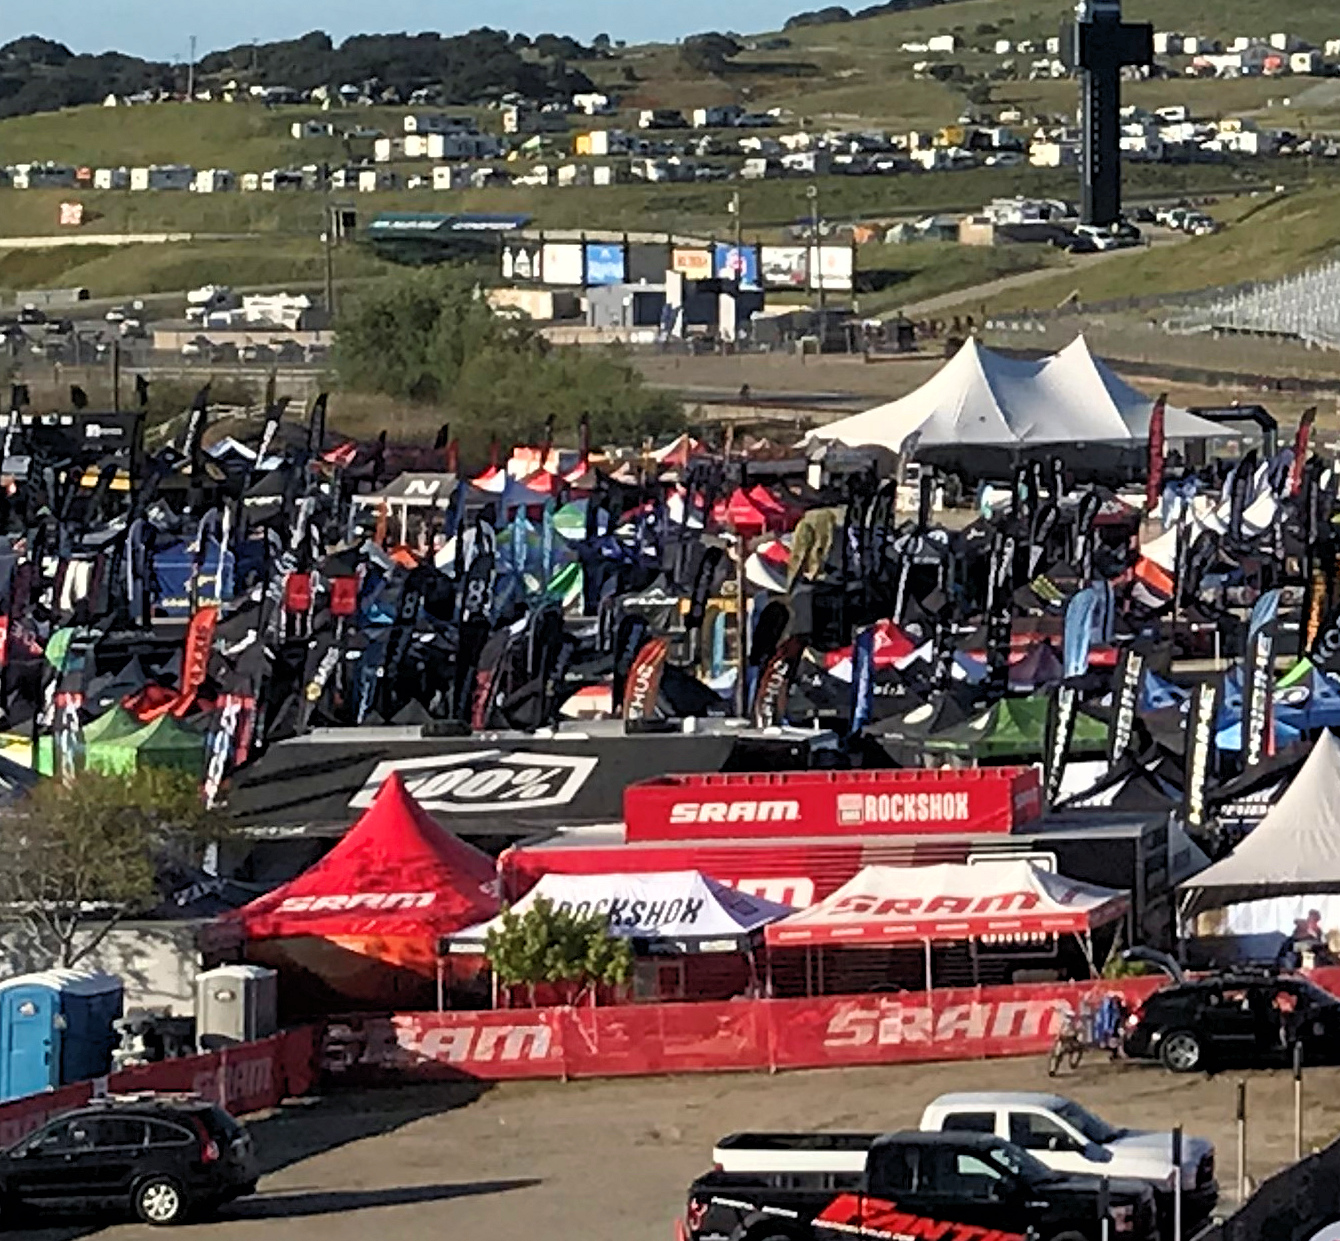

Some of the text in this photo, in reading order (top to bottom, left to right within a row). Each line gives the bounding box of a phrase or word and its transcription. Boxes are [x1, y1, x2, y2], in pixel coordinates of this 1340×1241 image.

[669, 800, 801, 824] SRAM
[864, 792, 969, 822] ROCKSHOX
[277, 893, 436, 912] SRAM
[830, 893, 1040, 915] SRAM
[824, 999, 1072, 1045] SRAM
